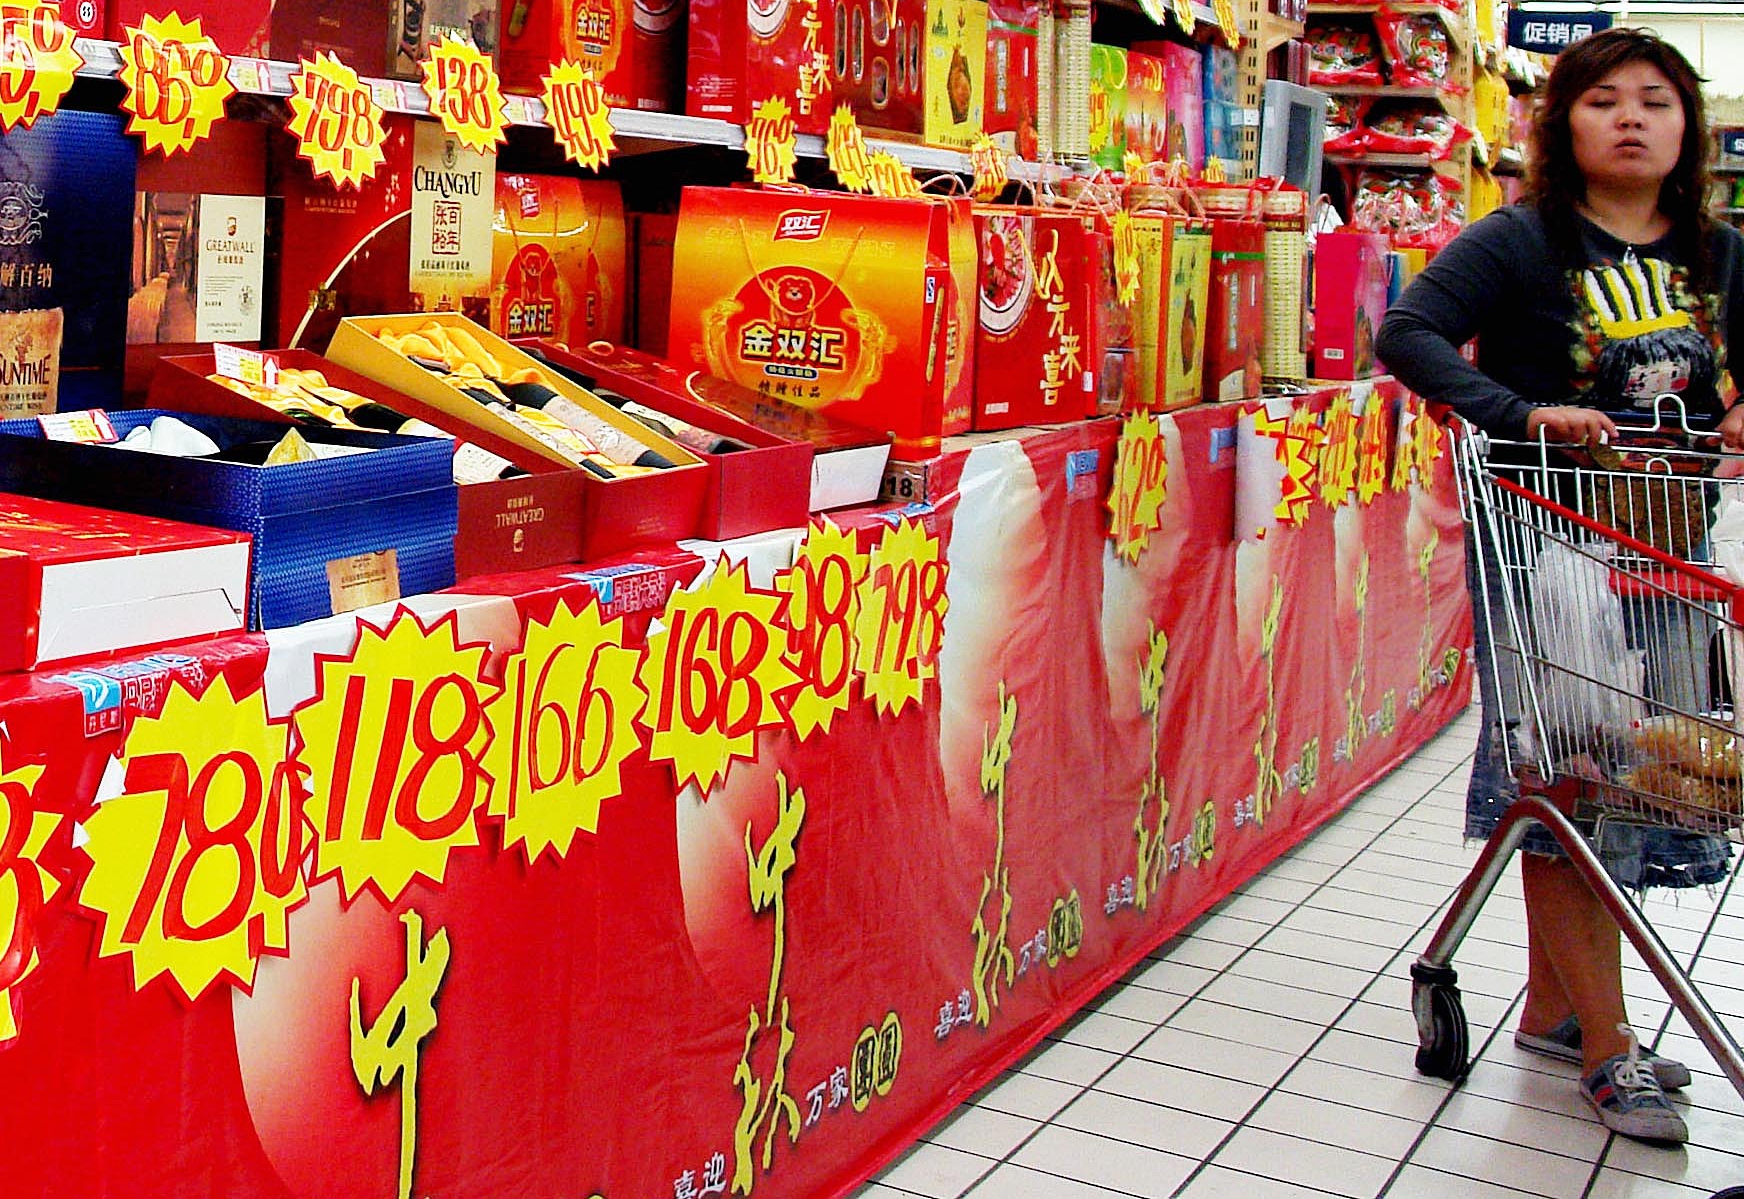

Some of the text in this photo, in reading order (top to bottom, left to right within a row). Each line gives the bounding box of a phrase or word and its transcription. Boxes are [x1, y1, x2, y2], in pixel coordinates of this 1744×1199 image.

[575, 7, 612, 45] 金双汇
[1524, 20, 1593, 45] 促销品
[434, 59, 493, 129] 138
[414, 165, 482, 198] CHANGYU
[782, 214, 823, 234] 双汇
[205, 239, 255, 254] GREATWALL
[0, 261, 53, 289] 解百纳
[508, 301, 555, 335] 金双汇
[742, 326, 846, 365] 金双汇
[657, 607, 770, 739] 168
[509, 644, 615, 795] 166
[326, 672, 486, 843] 118
